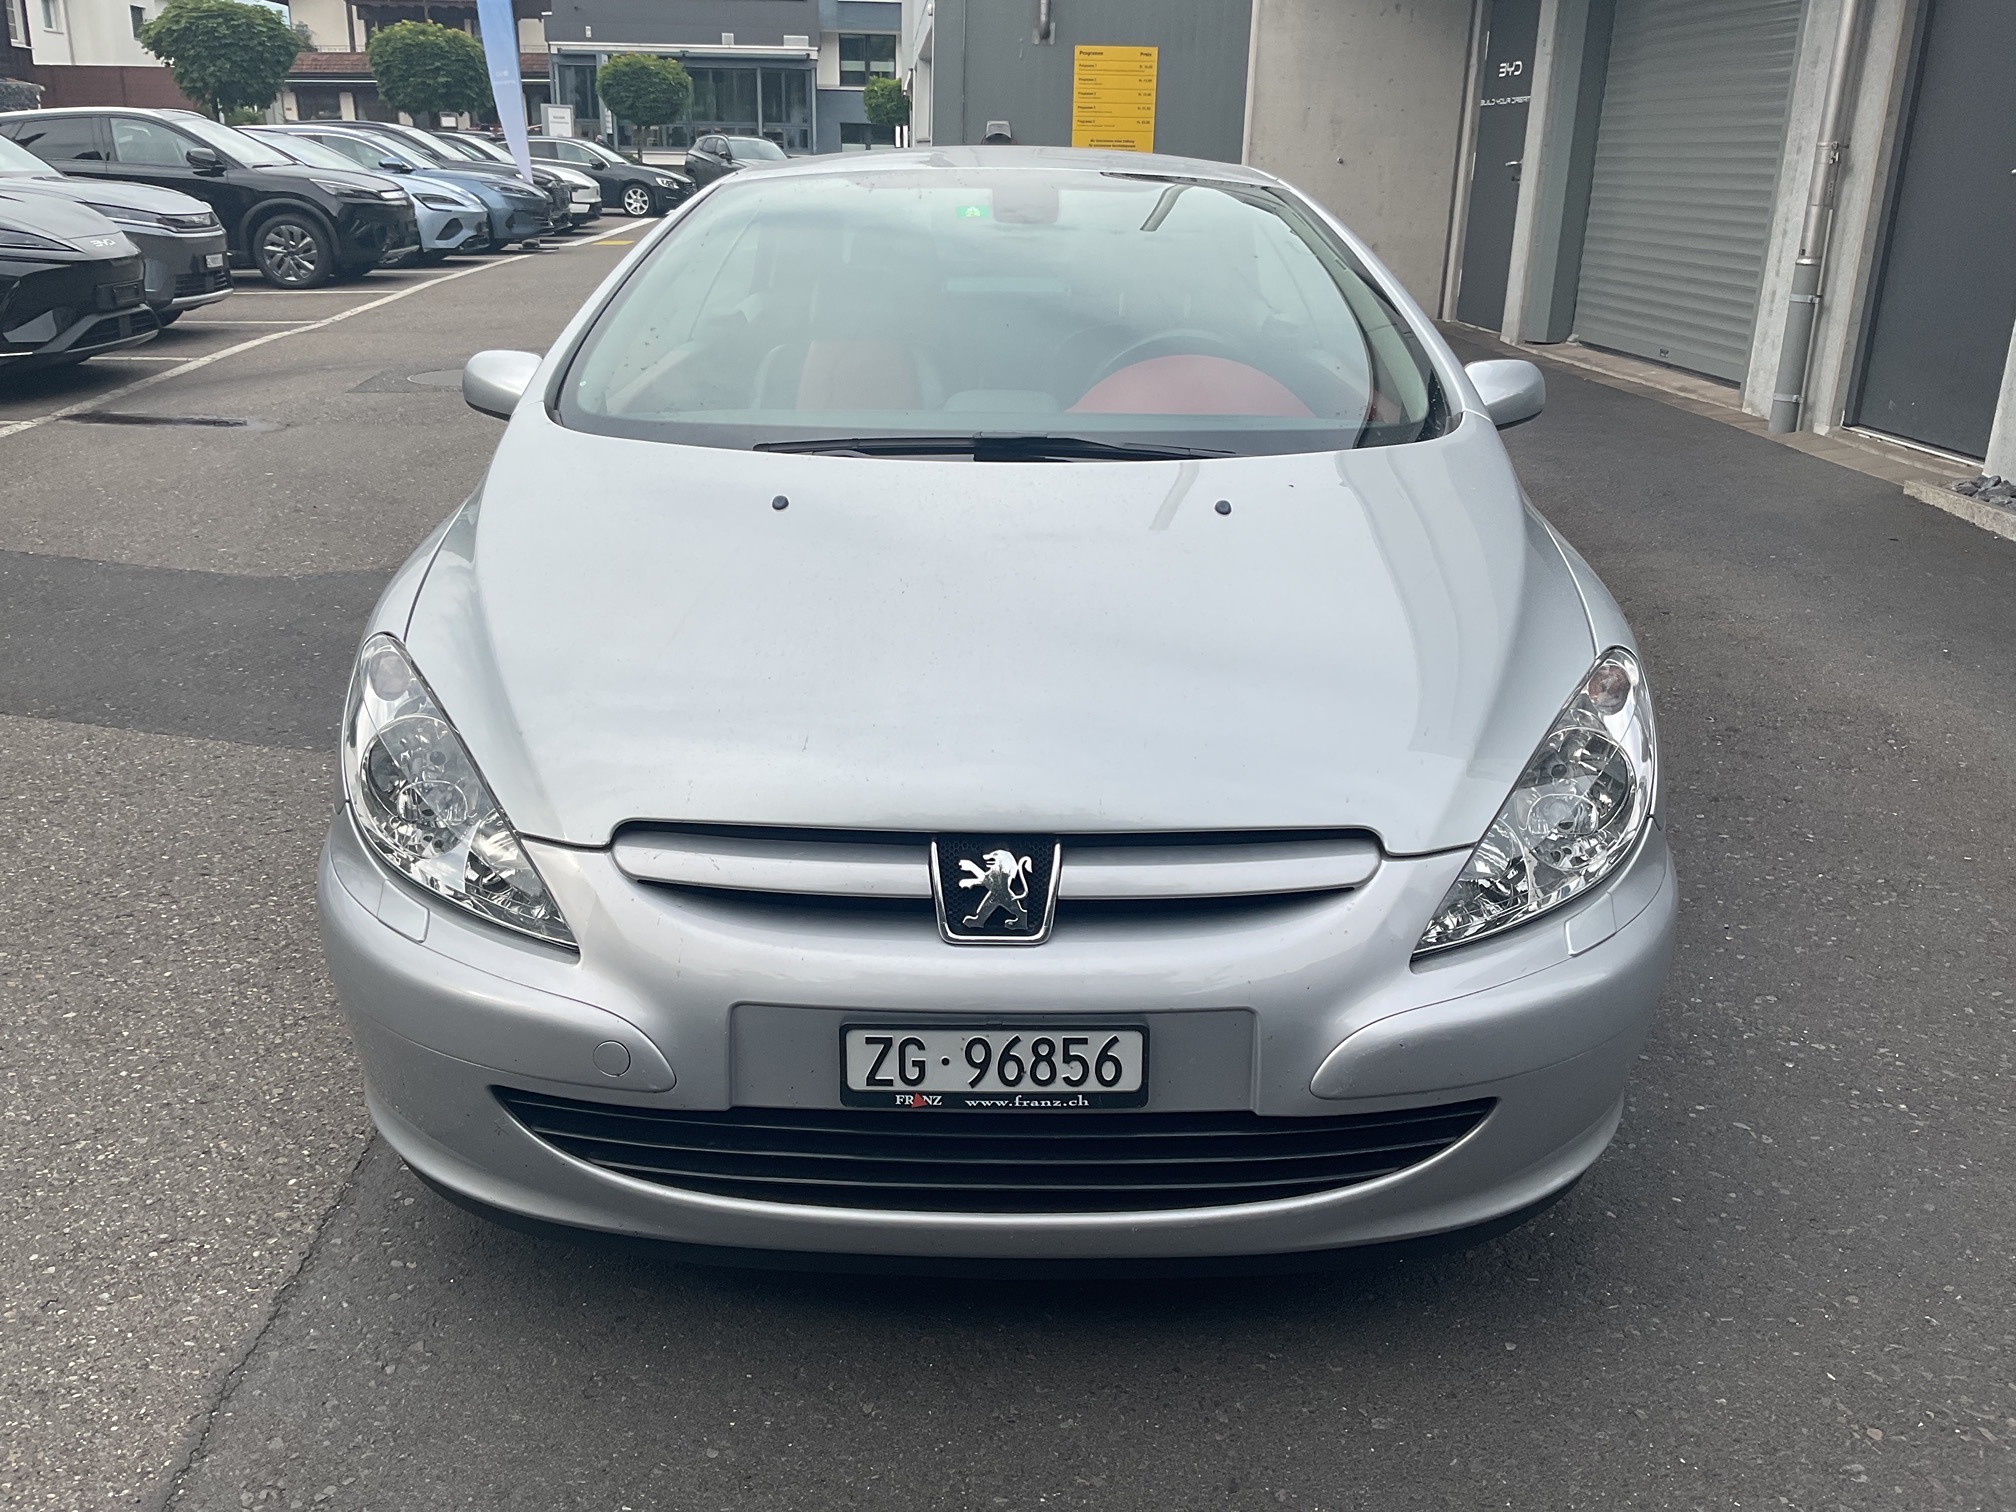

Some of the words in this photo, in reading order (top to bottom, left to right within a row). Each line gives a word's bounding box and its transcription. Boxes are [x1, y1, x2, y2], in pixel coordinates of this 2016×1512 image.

[1498, 60, 1523, 77] BYD
[964, 1034, 1123, 1089] 96856
[895, 1093, 942, 1107] FRANZ
[965, 1095, 1089, 1107] www.franz.ch
